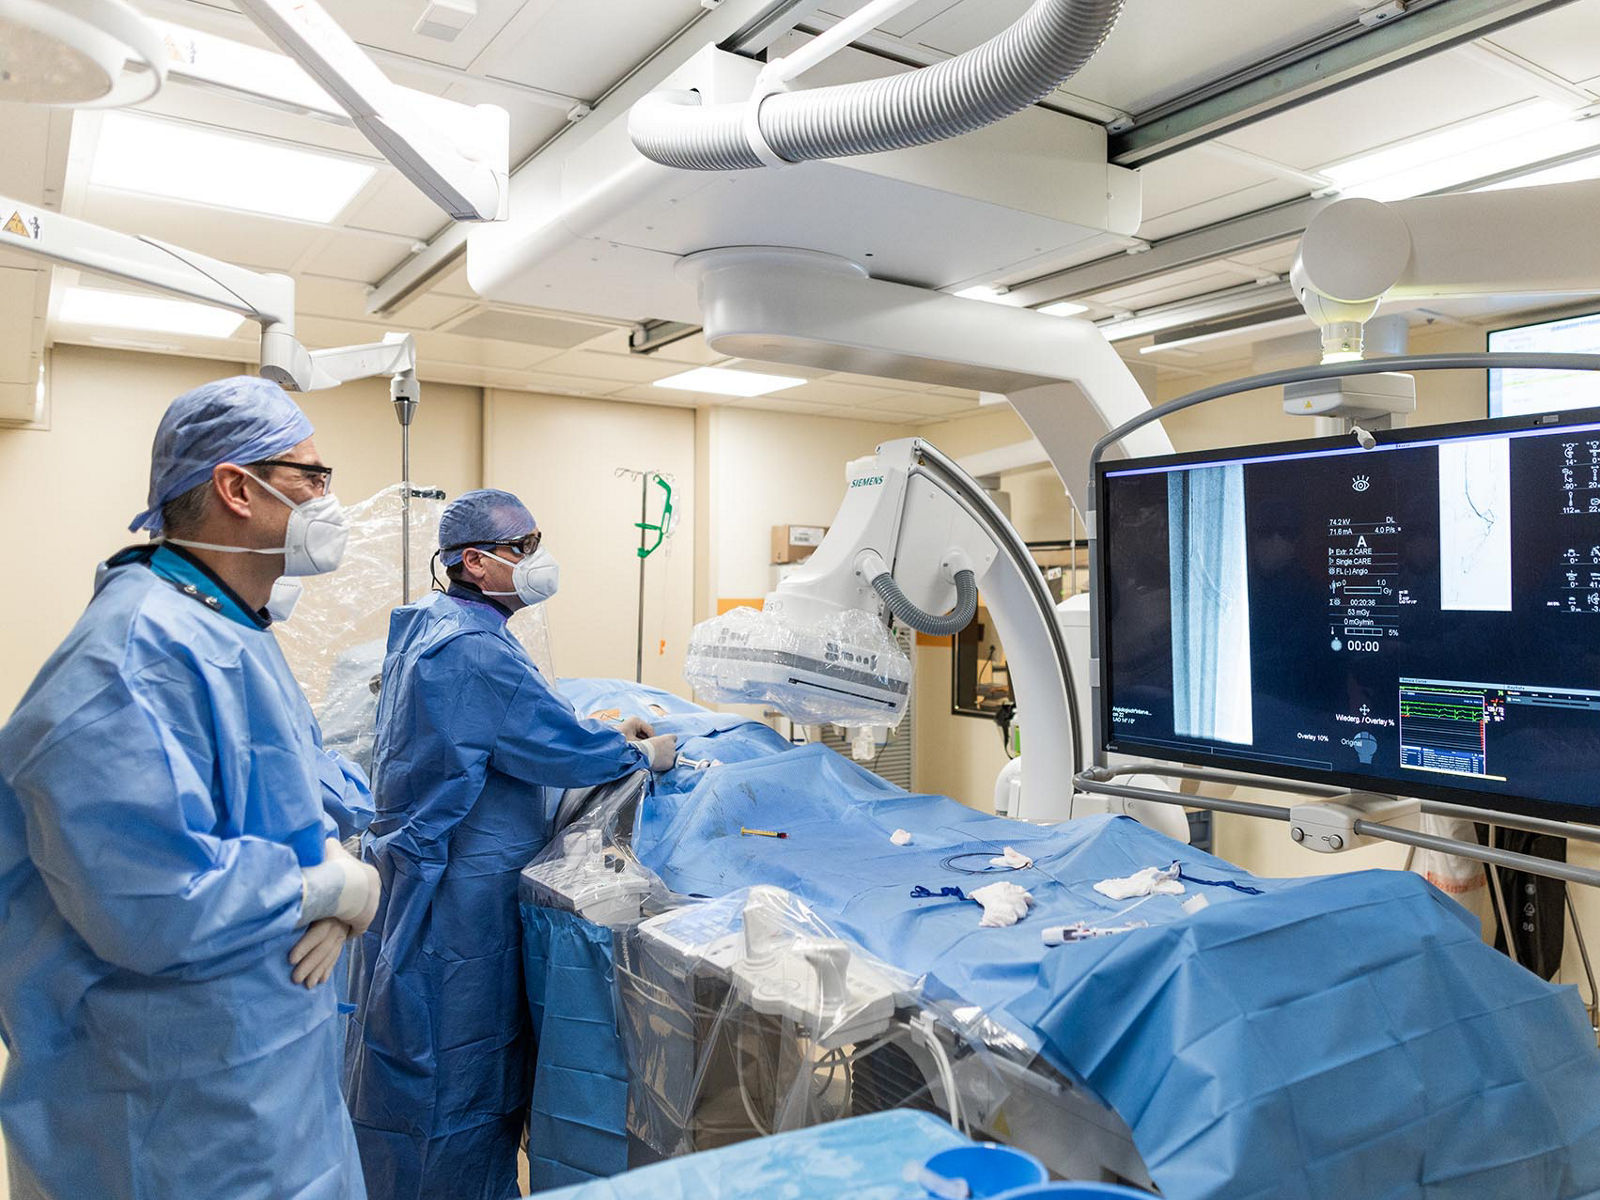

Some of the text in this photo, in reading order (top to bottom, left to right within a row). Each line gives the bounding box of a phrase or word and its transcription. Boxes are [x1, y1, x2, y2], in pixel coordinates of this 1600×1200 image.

[851, 476, 884, 488] SIEMENS
[1329, 518, 1342, 526] 74.2
[1357, 536, 1367, 547] A
[1336, 558, 1352, 566] Single
[1356, 609, 1370, 617] mGy
[1349, 618, 1374, 626] mGy/min
[1348, 640, 1380, 651] 00:00
[1365, 717, 1387, 727] Overlay
[1297, 732, 1329, 742] Overlay 10%
[1341, 738, 1362, 747] Original
